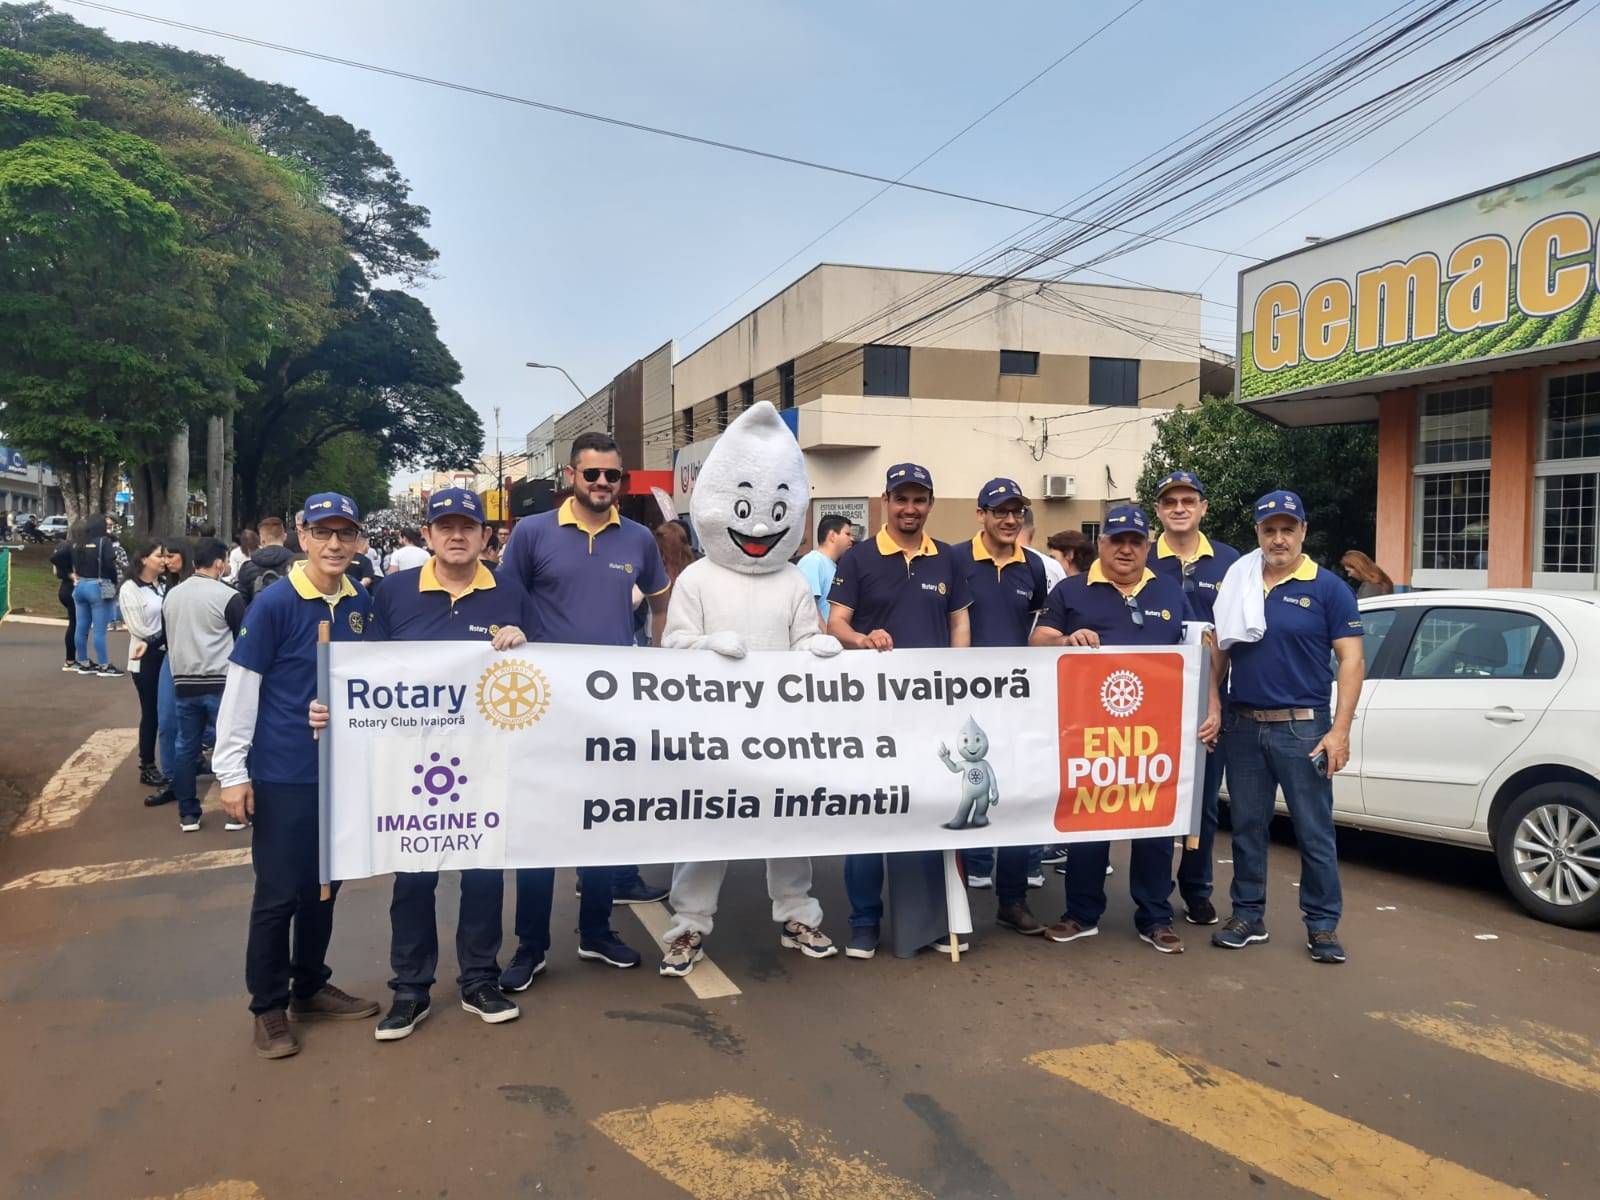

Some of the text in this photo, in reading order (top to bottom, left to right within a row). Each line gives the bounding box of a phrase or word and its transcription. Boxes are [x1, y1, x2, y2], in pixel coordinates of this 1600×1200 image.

[1252, 211, 1600, 372] Gemac
[469, 624, 488, 635] Rotary
[347, 679, 467, 713] Rotary
[586, 668, 1031, 708] O Rotary Club Ivaiporã
[348, 714, 465, 729] Rotary Club Ivaiporã
[585, 729, 897, 761] na luta contra a
[1084, 725, 1159, 758] END
[1067, 753, 1173, 789] POLIO
[582, 785, 910, 830] paralisia infantil
[1072, 783, 1161, 814] NOW
[377, 811, 500, 833] IMAGINE O
[400, 834, 483, 854] ROTARY
